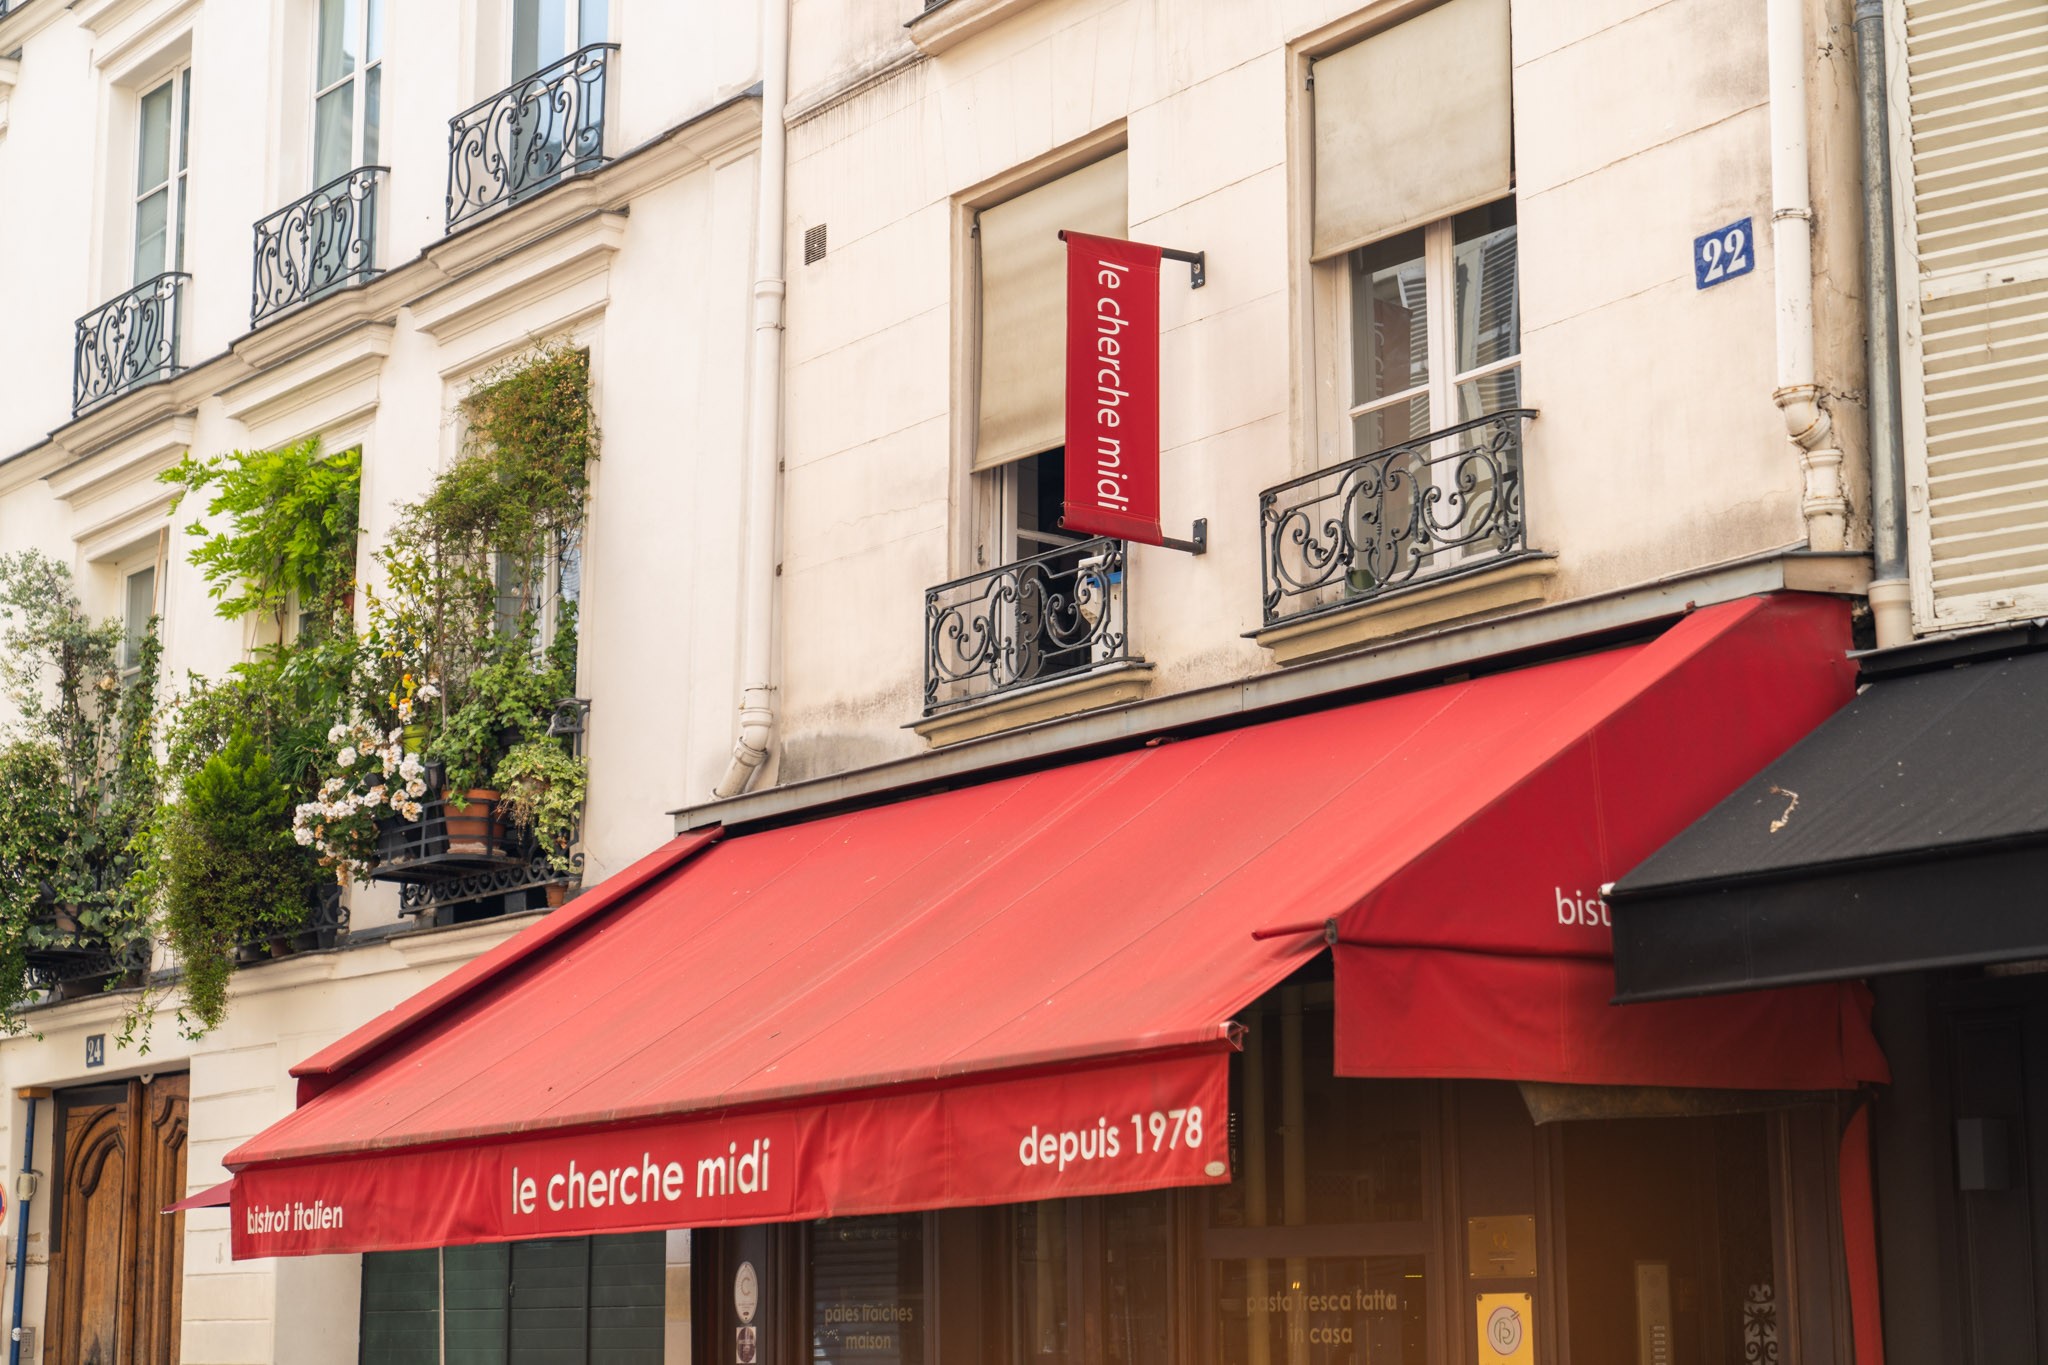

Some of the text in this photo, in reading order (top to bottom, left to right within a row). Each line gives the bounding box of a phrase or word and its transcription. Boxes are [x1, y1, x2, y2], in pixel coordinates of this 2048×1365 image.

[1702, 228, 1747, 283] 22
[1097, 260, 1129, 512] le cherche midi
[88, 1038, 101, 1064] 24
[1019, 1106, 1203, 1172] depuis 1978
[512, 1137, 770, 1215] le cherche midi
[247, 1199, 343, 1235] bistrot italien
[1246, 1289, 1397, 1317] pasta fresca fatta
[845, 1331, 892, 1350] maison
[1288, 1322, 1353, 1345] in casa
